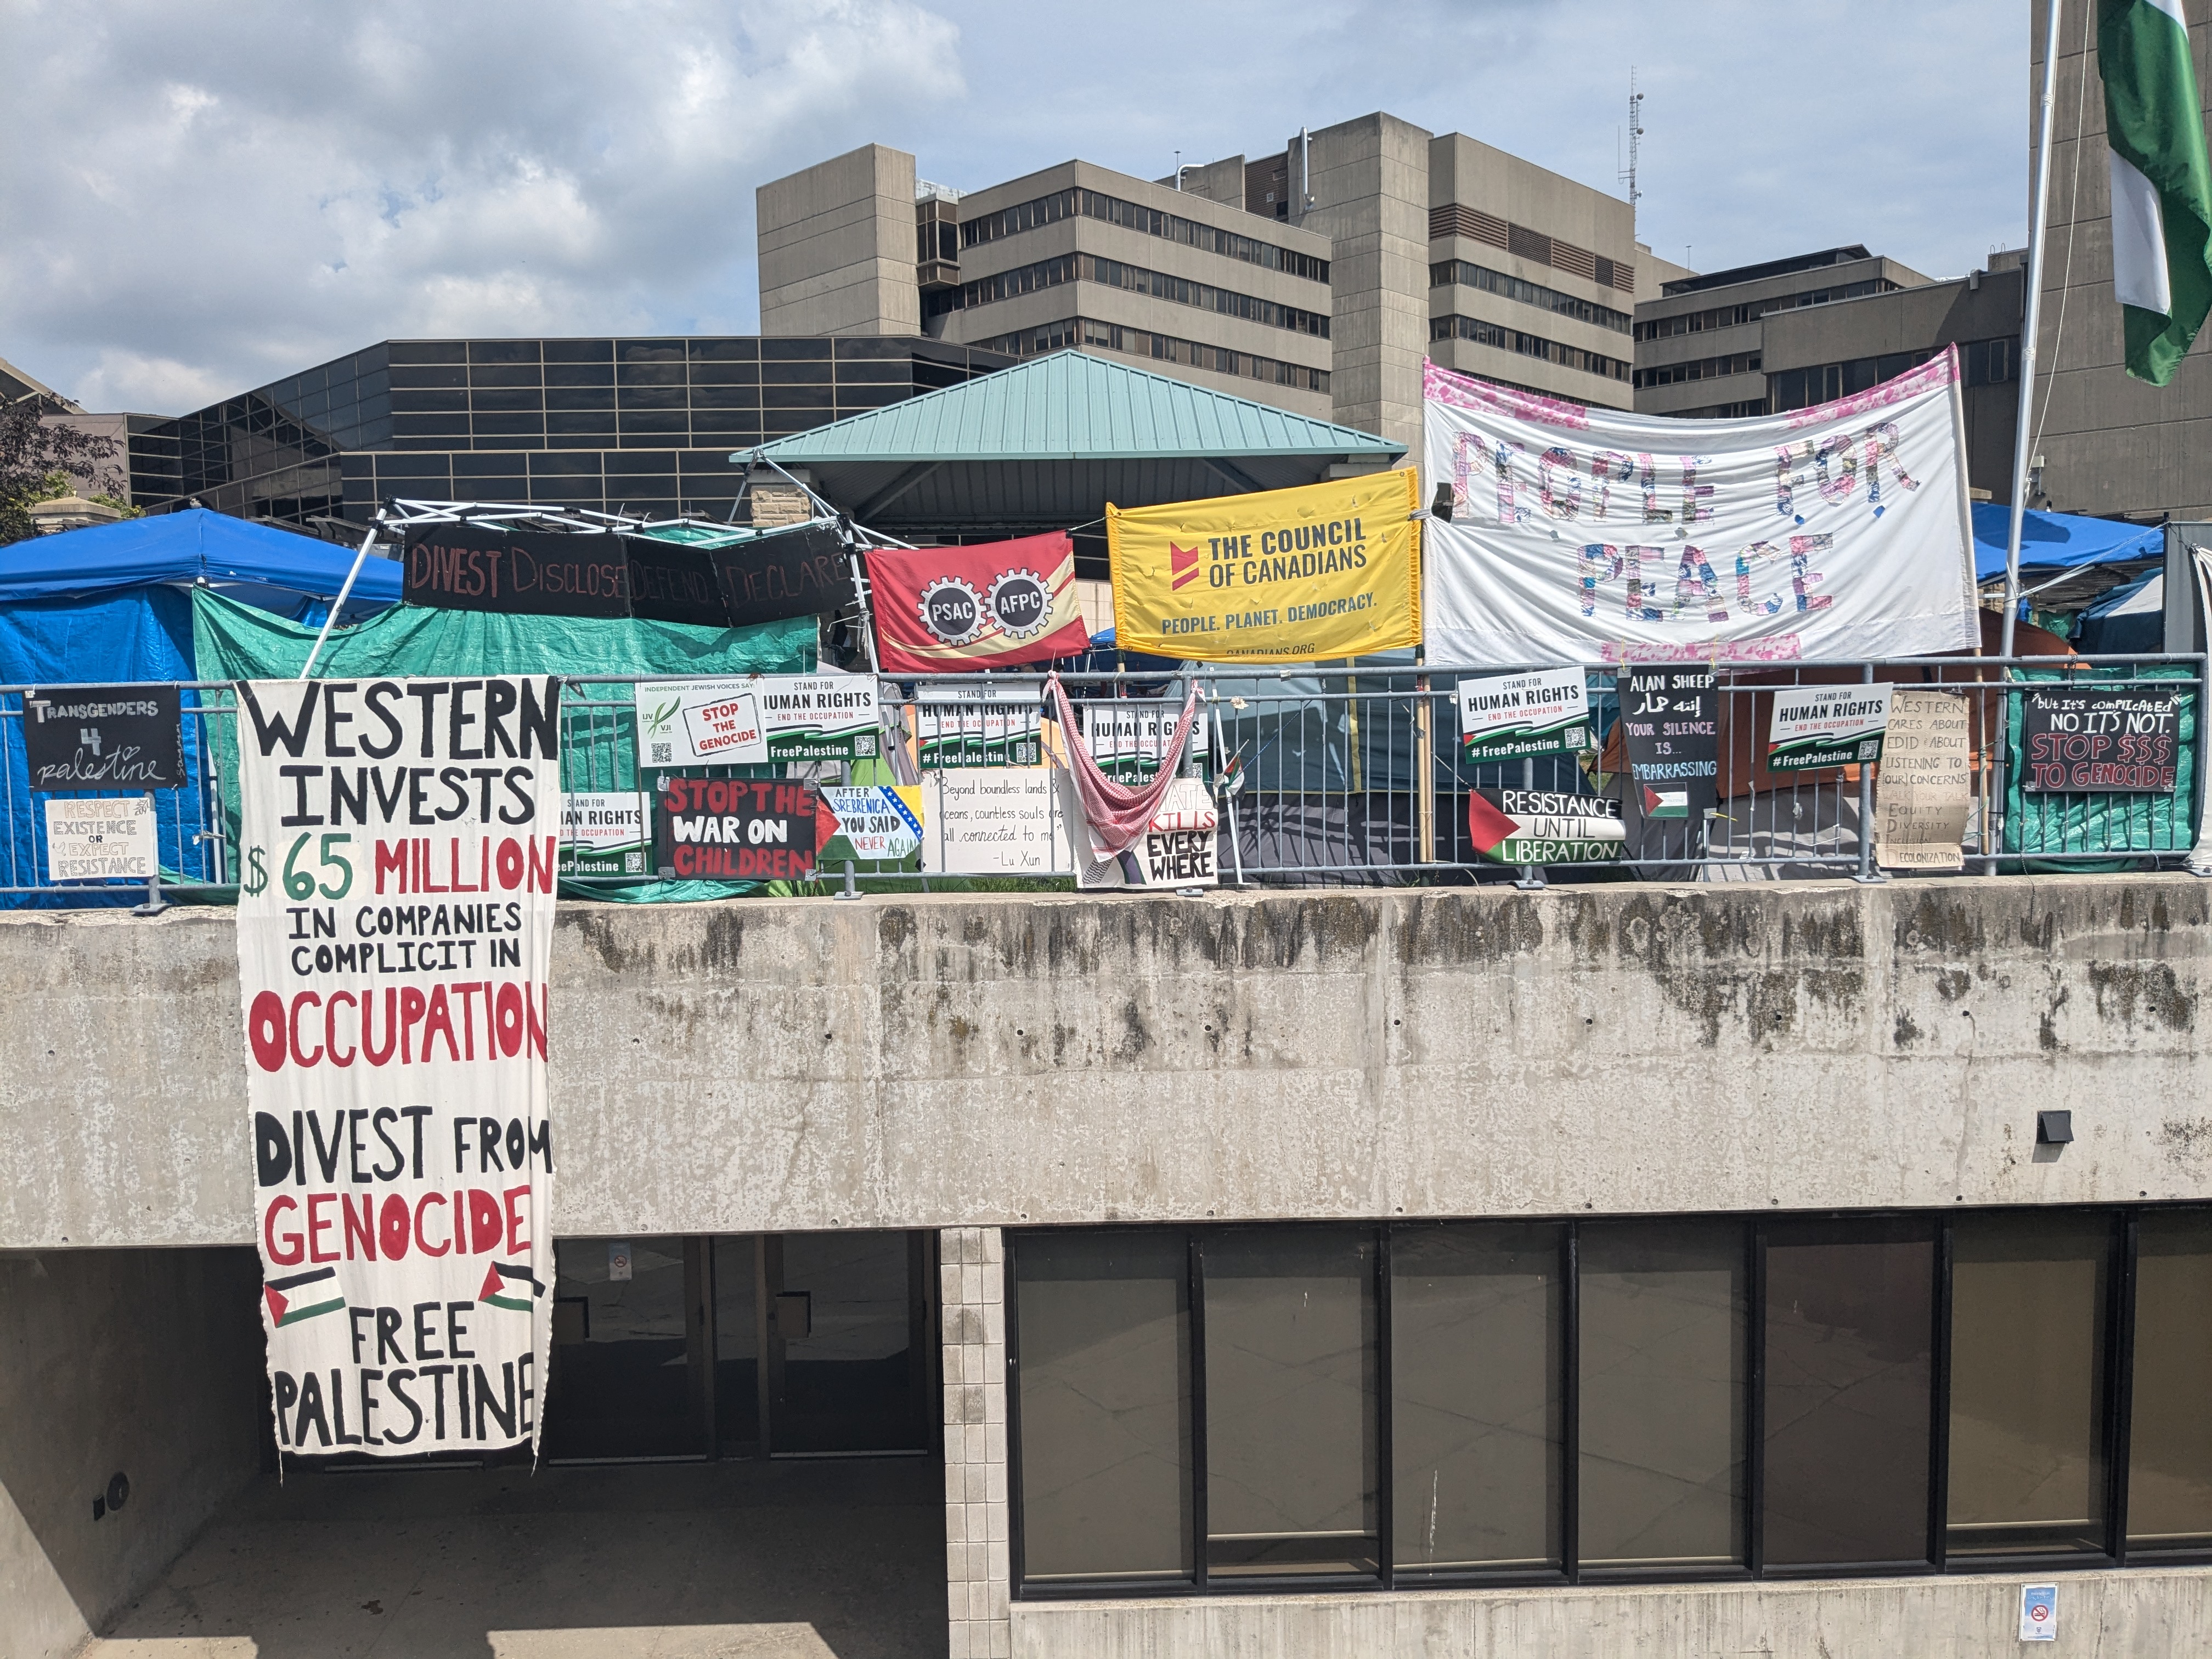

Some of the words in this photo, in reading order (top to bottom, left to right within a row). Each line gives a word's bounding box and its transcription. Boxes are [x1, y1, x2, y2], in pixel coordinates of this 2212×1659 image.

[1452, 431, 1714, 524] PEOPLE
[1774, 421, 1921, 516] FOR
[1208, 534, 1252, 561] THE
[1261, 517, 1366, 556] COUNCIL
[411, 543, 503, 597] DIVEST
[630, 559, 709, 603] DEFEND
[726, 551, 848, 608] DECLARE
[1209, 563, 1235, 588] OF
[1243, 544, 1367, 584] CANADIANS
[1577, 532, 1833, 624] PEACE
[932, 602, 972, 622] PSAC
[1001, 591, 1040, 614] AFPC
[1162, 615, 1220, 635] PEOPLE.
[1226, 609, 1283, 630] PLANET.
[1288, 591, 1377, 622] DEMOCRACY.
[794, 681, 817, 691] STAND
[820, 681, 834, 690] FOR
[1503, 680, 1525, 690] STAND
[1528, 678, 1542, 686] FOR
[1630, 675, 1665, 692] ALAN
[1672, 674, 1714, 689] SHEEP
[817, 692, 871, 708] RIGHTS
[958, 690, 980, 698] STAND
[1468, 692, 1520, 712] HUMAN
[1526, 685, 1579, 705] RIGHTS
[1815, 693, 1837, 702] STAND
[1839, 691, 1852, 699] FOR
[702, 703, 738, 721] STOP
[1488, 713, 1501, 721] END
[1520, 705, 1562, 717] OCCUPATION
[1779, 704, 1828, 722] HUMAN
[1833, 700, 1883, 717] RIGHTS
[1891, 696, 1963, 713] WESTERN
[235, 678, 560, 760] WESTERN
[713, 719, 736, 733] THE
[810, 712, 854, 720] OCCUPATION
[1824, 719, 1864, 729] OCCUPATION
[1887, 719, 1922, 730] CARES
[1929, 719, 1967, 730] ABOUT
[2051, 713, 2079, 732] NO
[2126, 713, 2174, 734] NOT.
[1626, 723, 1655, 736] YOUR
[1662, 721, 1716, 735] SILENCE
[80, 728, 101, 755] 4
[699, 729, 757, 751] GENOCIDE
[1655, 742, 1681, 754] IS...
[1887, 736, 1918, 749] EDID
[1929, 736, 1966, 748] ABOUT
[2032, 733, 2112, 761] STOP
[2118, 733, 2172, 764] $$$
[771, 744, 849, 758] FreePalestine
[37, 744, 166, 785] palestine
[1632, 760, 1717, 780] EMBARRASSING
[1886, 757, 1940, 770] LISTENING
[1946, 757, 1962, 769] TO
[2032, 763, 2066, 788] TO
[2072, 763, 2176, 787] GENOCIDE
[280, 765, 535, 826] INVESTS
[836, 788, 870, 797] AFTER
[980, 778, 1020, 794] boundless
[1025, 778, 1047, 794] lands
[567, 799, 589, 808] SAND
[664, 778, 748, 814] STOP
[751, 783, 814, 816] THE
[833, 798, 890, 814] SREBRENICA
[1503, 790, 1618, 819] RESISTANCE
[64, 800, 130, 818] RESPECT
[589, 810, 641, 825] RIGHTS
[975, 806, 1015, 819] countless
[1020, 806, 1045, 819] souls
[1889, 803, 1942, 817] EQUITY
[54, 820, 137, 835] EXISTENCE
[673, 816, 740, 843] WAR
[748, 819, 787, 844] ON
[842, 817, 865, 833] YOU
[868, 816, 900, 833] SAID
[1149, 811, 1216, 832] KILLS
[1533, 817, 1595, 838] UNTIL
[1887, 819, 1949, 833] DIVERSITY
[89, 835, 103, 843] OR
[944, 827, 954, 842] all
[960, 825, 1017, 842] connected
[1023, 825, 1034, 841] to
[69, 842, 129, 856] EXPECT
[855, 836, 885, 850] NEVER
[888, 838, 916, 857] AGAIN
[1147, 831, 1212, 857] EVERY
[1502, 839, 1617, 862] LIBERATION
[58, 857, 146, 877] RESISTANCE
[375, 834, 556, 894] MILLION
[674, 844, 813, 877] CHILDREN
[1020, 850, 1040, 866] Xun
[1149, 851, 1214, 881] WHERE
[1886, 849, 1960, 866] DECOLONIZATION
[286, 907, 336, 939] IN
[357, 902, 522, 937] COMPANIES
[292, 940, 476, 976] COMPLICIT
[490, 939, 521, 968] IN
[249, 981, 548, 1072] OCCUPATION
[255, 1106, 432, 1187] DIVEST
[454, 1116, 552, 1173] FROM
[264, 1185, 531, 1265] GENOCIDE
[348, 1301, 475, 1365] FREE
[274, 1352, 534, 1447] PALESTINE
